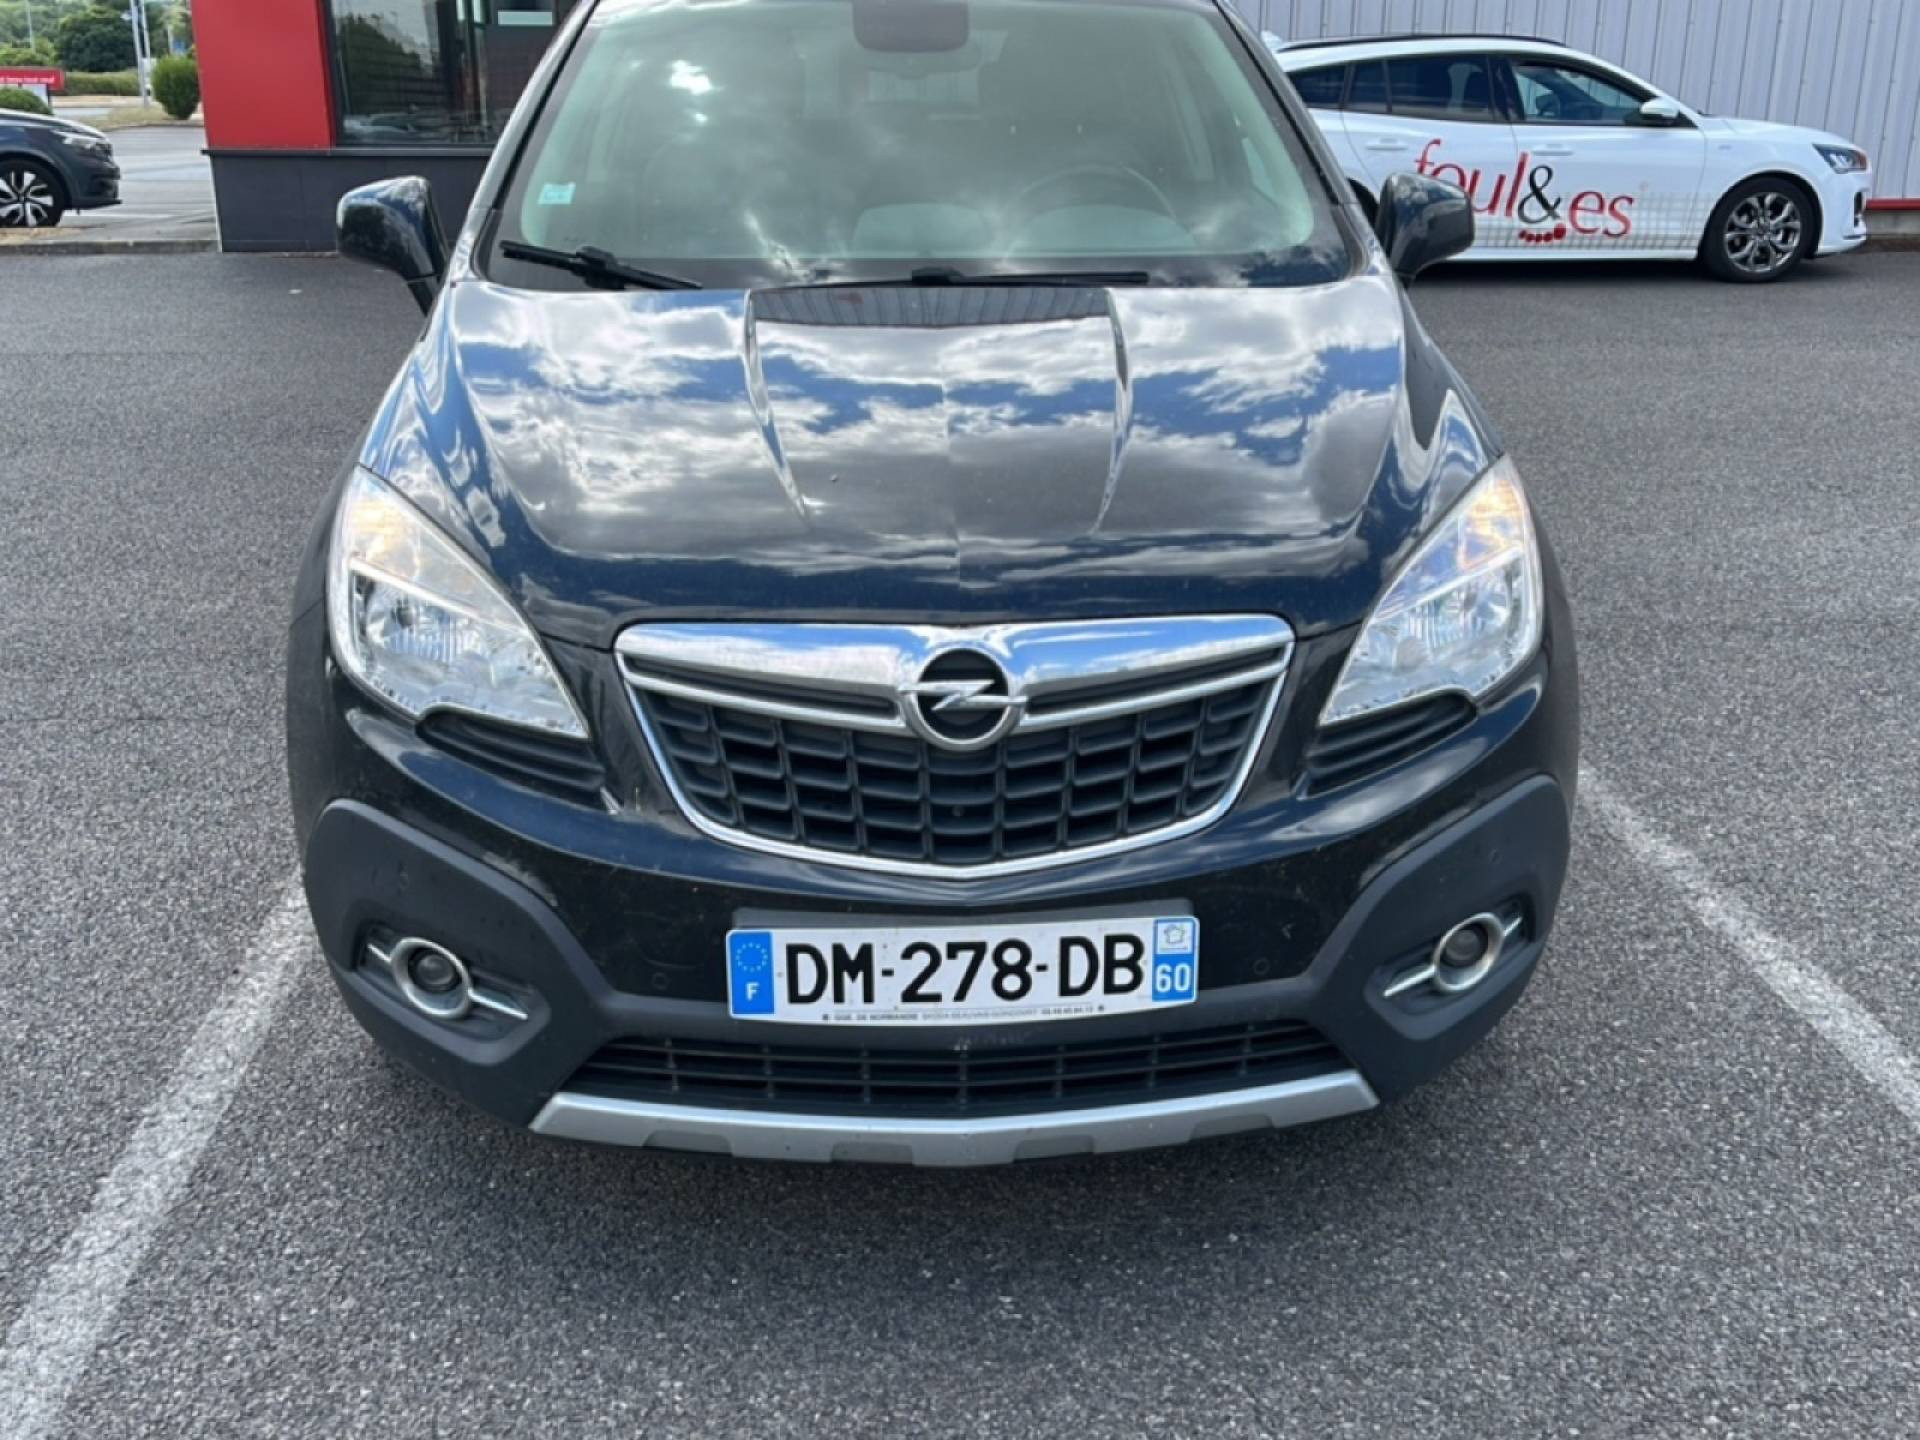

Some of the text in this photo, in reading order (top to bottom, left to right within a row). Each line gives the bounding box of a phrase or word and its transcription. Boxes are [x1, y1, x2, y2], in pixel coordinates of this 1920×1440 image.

[785, 932, 1146, 1005] DM-278-DB
[1155, 963, 1191, 993] 60
[745, 982, 758, 1002] F
